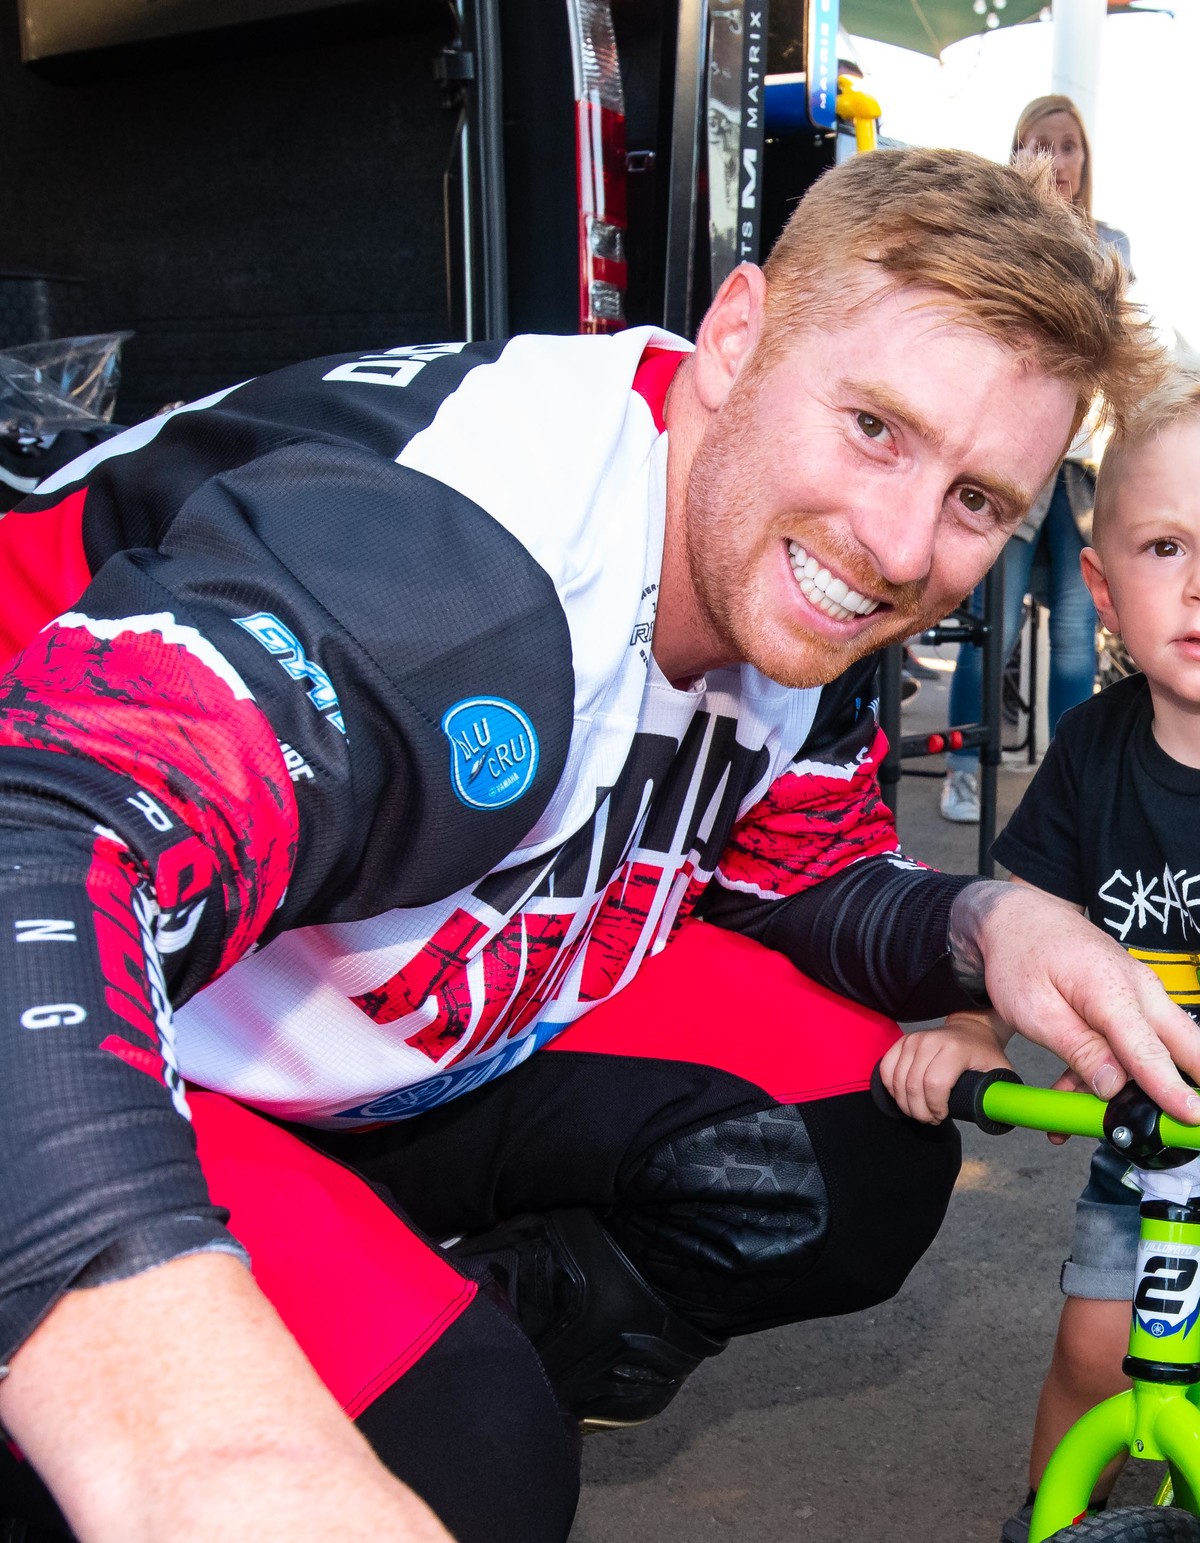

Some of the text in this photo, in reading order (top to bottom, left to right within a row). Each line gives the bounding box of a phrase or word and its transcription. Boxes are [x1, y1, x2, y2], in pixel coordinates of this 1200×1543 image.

[740, 222, 753, 264] TS
[747, 11, 762, 128] MATRIX
[1135, 1255, 1199, 1314] 2
